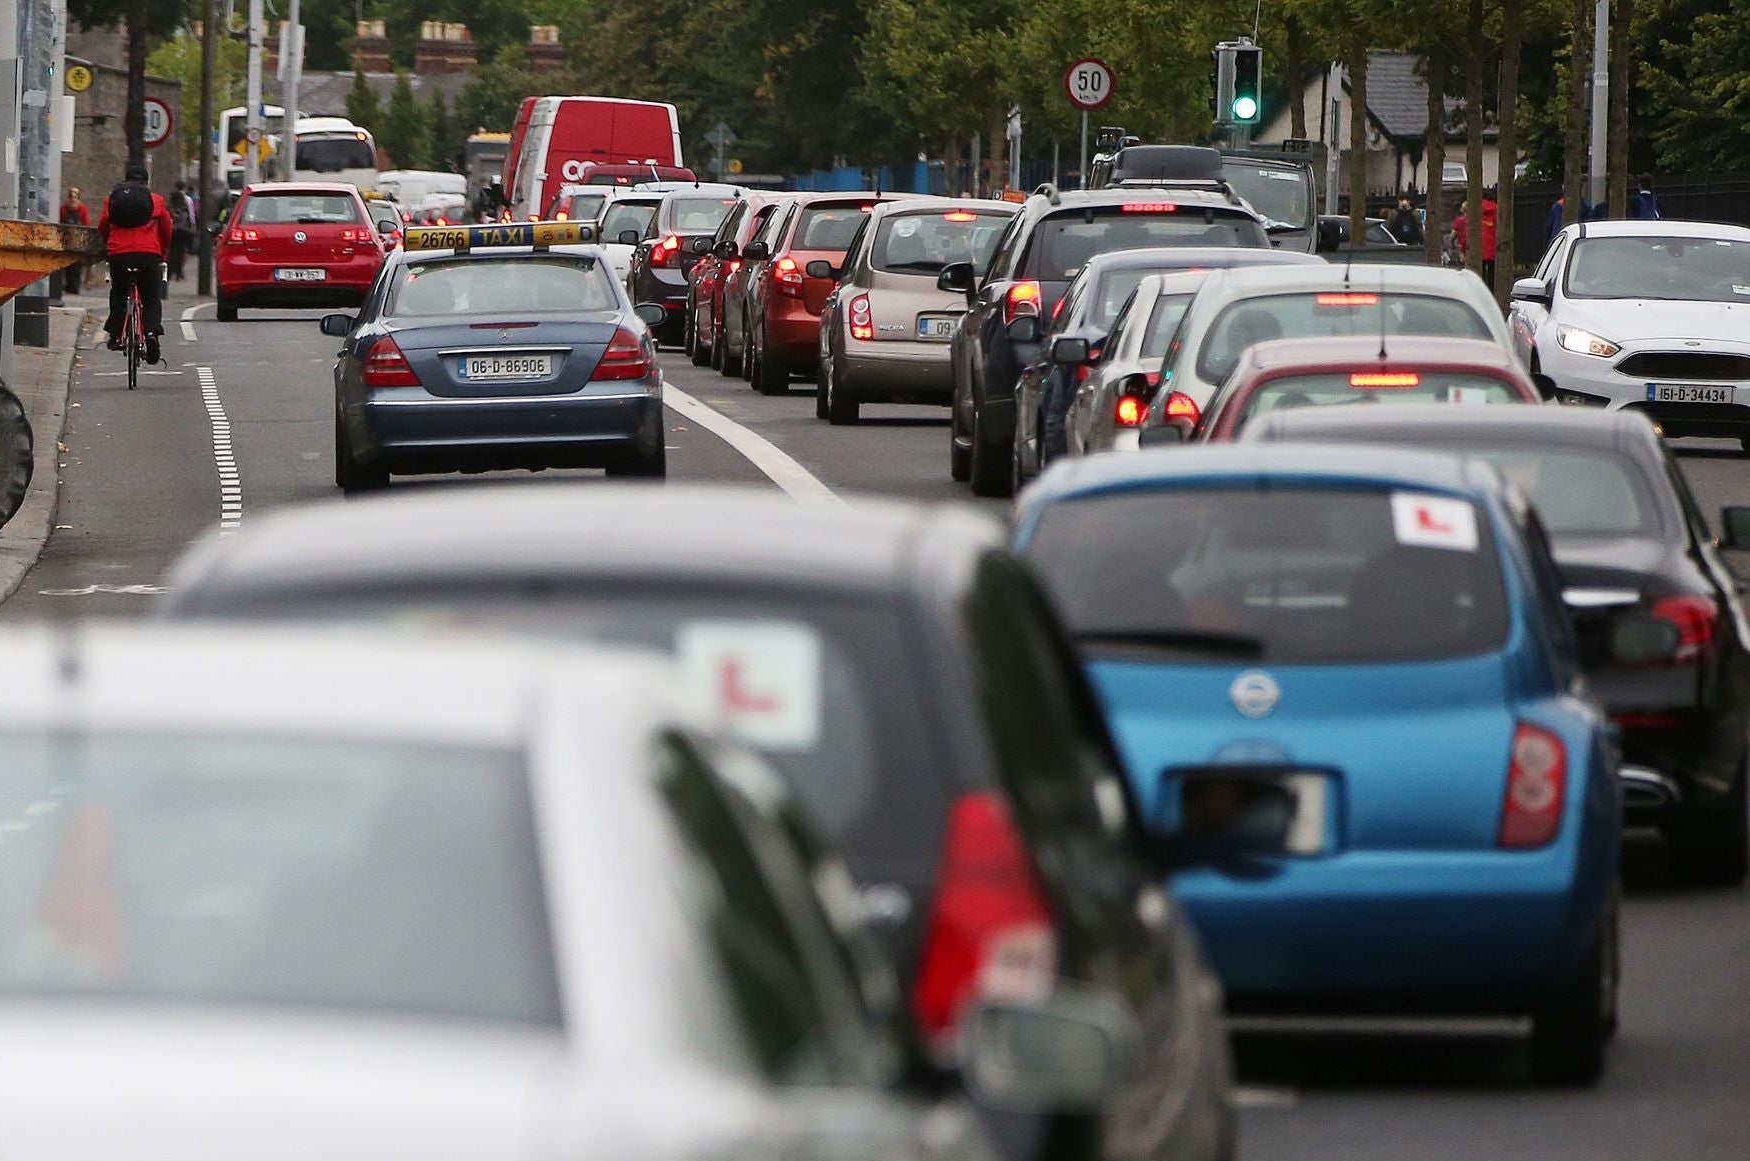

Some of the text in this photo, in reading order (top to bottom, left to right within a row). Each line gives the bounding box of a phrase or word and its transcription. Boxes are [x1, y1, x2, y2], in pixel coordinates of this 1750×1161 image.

[1078, 71, 1101, 92] 50
[421, 232, 465, 248] 26766
[478, 227, 525, 246] TAXI
[580, 226, 593, 241] D
[471, 359, 545, 374] 06-D-86906
[1659, 387, 1726, 402] 161-D-34434
[1416, 506, 1452, 534] L
[720, 658, 780, 714] L
